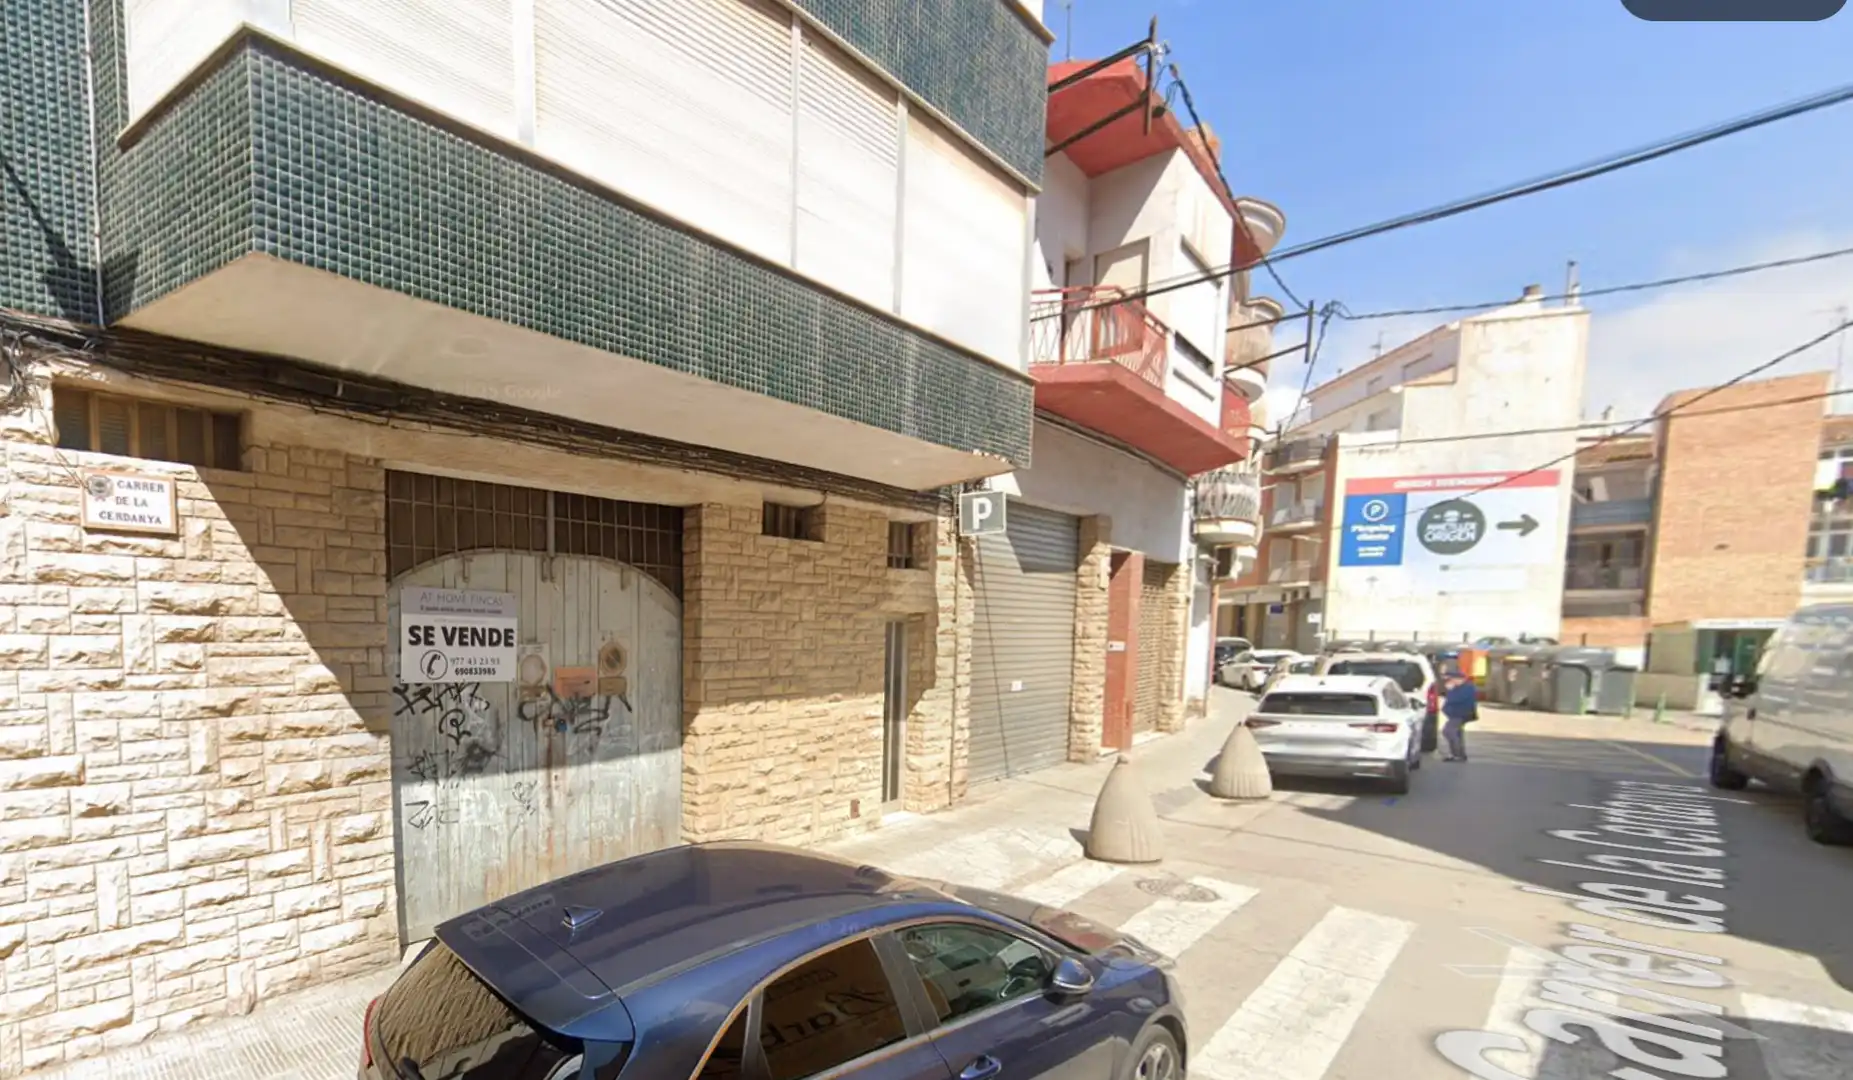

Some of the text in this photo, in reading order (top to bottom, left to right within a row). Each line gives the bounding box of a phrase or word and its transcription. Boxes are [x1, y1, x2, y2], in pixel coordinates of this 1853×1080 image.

[117, 480, 165, 493] CARRER
[116, 496, 148, 508] DE LA
[98, 510, 163, 525] CERDANYA
[972, 497, 993, 530] P
[420, 591, 503, 607] AT HOME FINCAS
[408, 624, 515, 648] SE VENDE
[450, 656, 465, 666] 977
